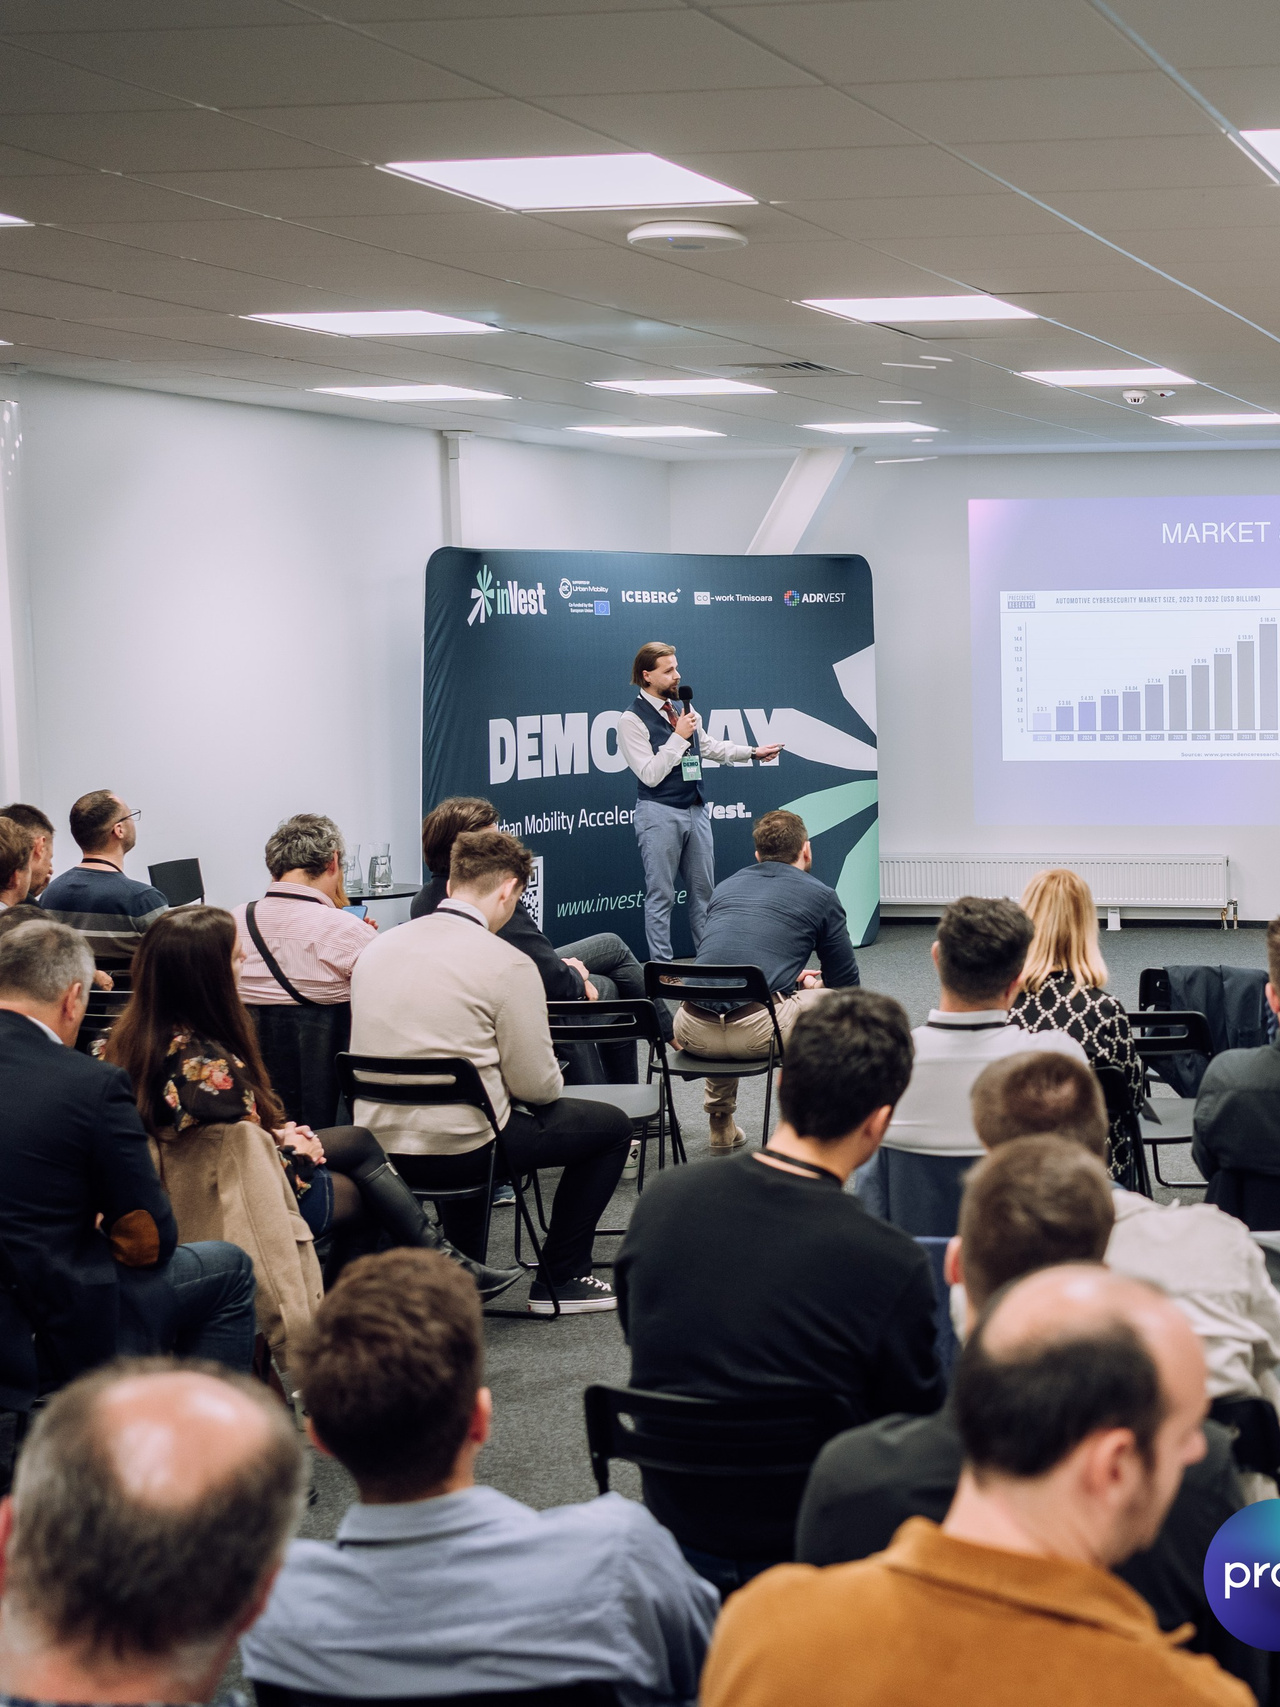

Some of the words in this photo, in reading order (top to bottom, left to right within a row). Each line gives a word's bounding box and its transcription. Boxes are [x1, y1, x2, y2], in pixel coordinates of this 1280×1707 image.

[1161, 521, 1271, 544] MARKET
[496, 580, 548, 615] inVest
[735, 594, 773, 602] Timisoara
[801, 592, 846, 603] ADRVEST
[488, 710, 629, 785] DEMO
[702, 707, 796, 769] AY
[524, 811, 575, 835] Mobility
